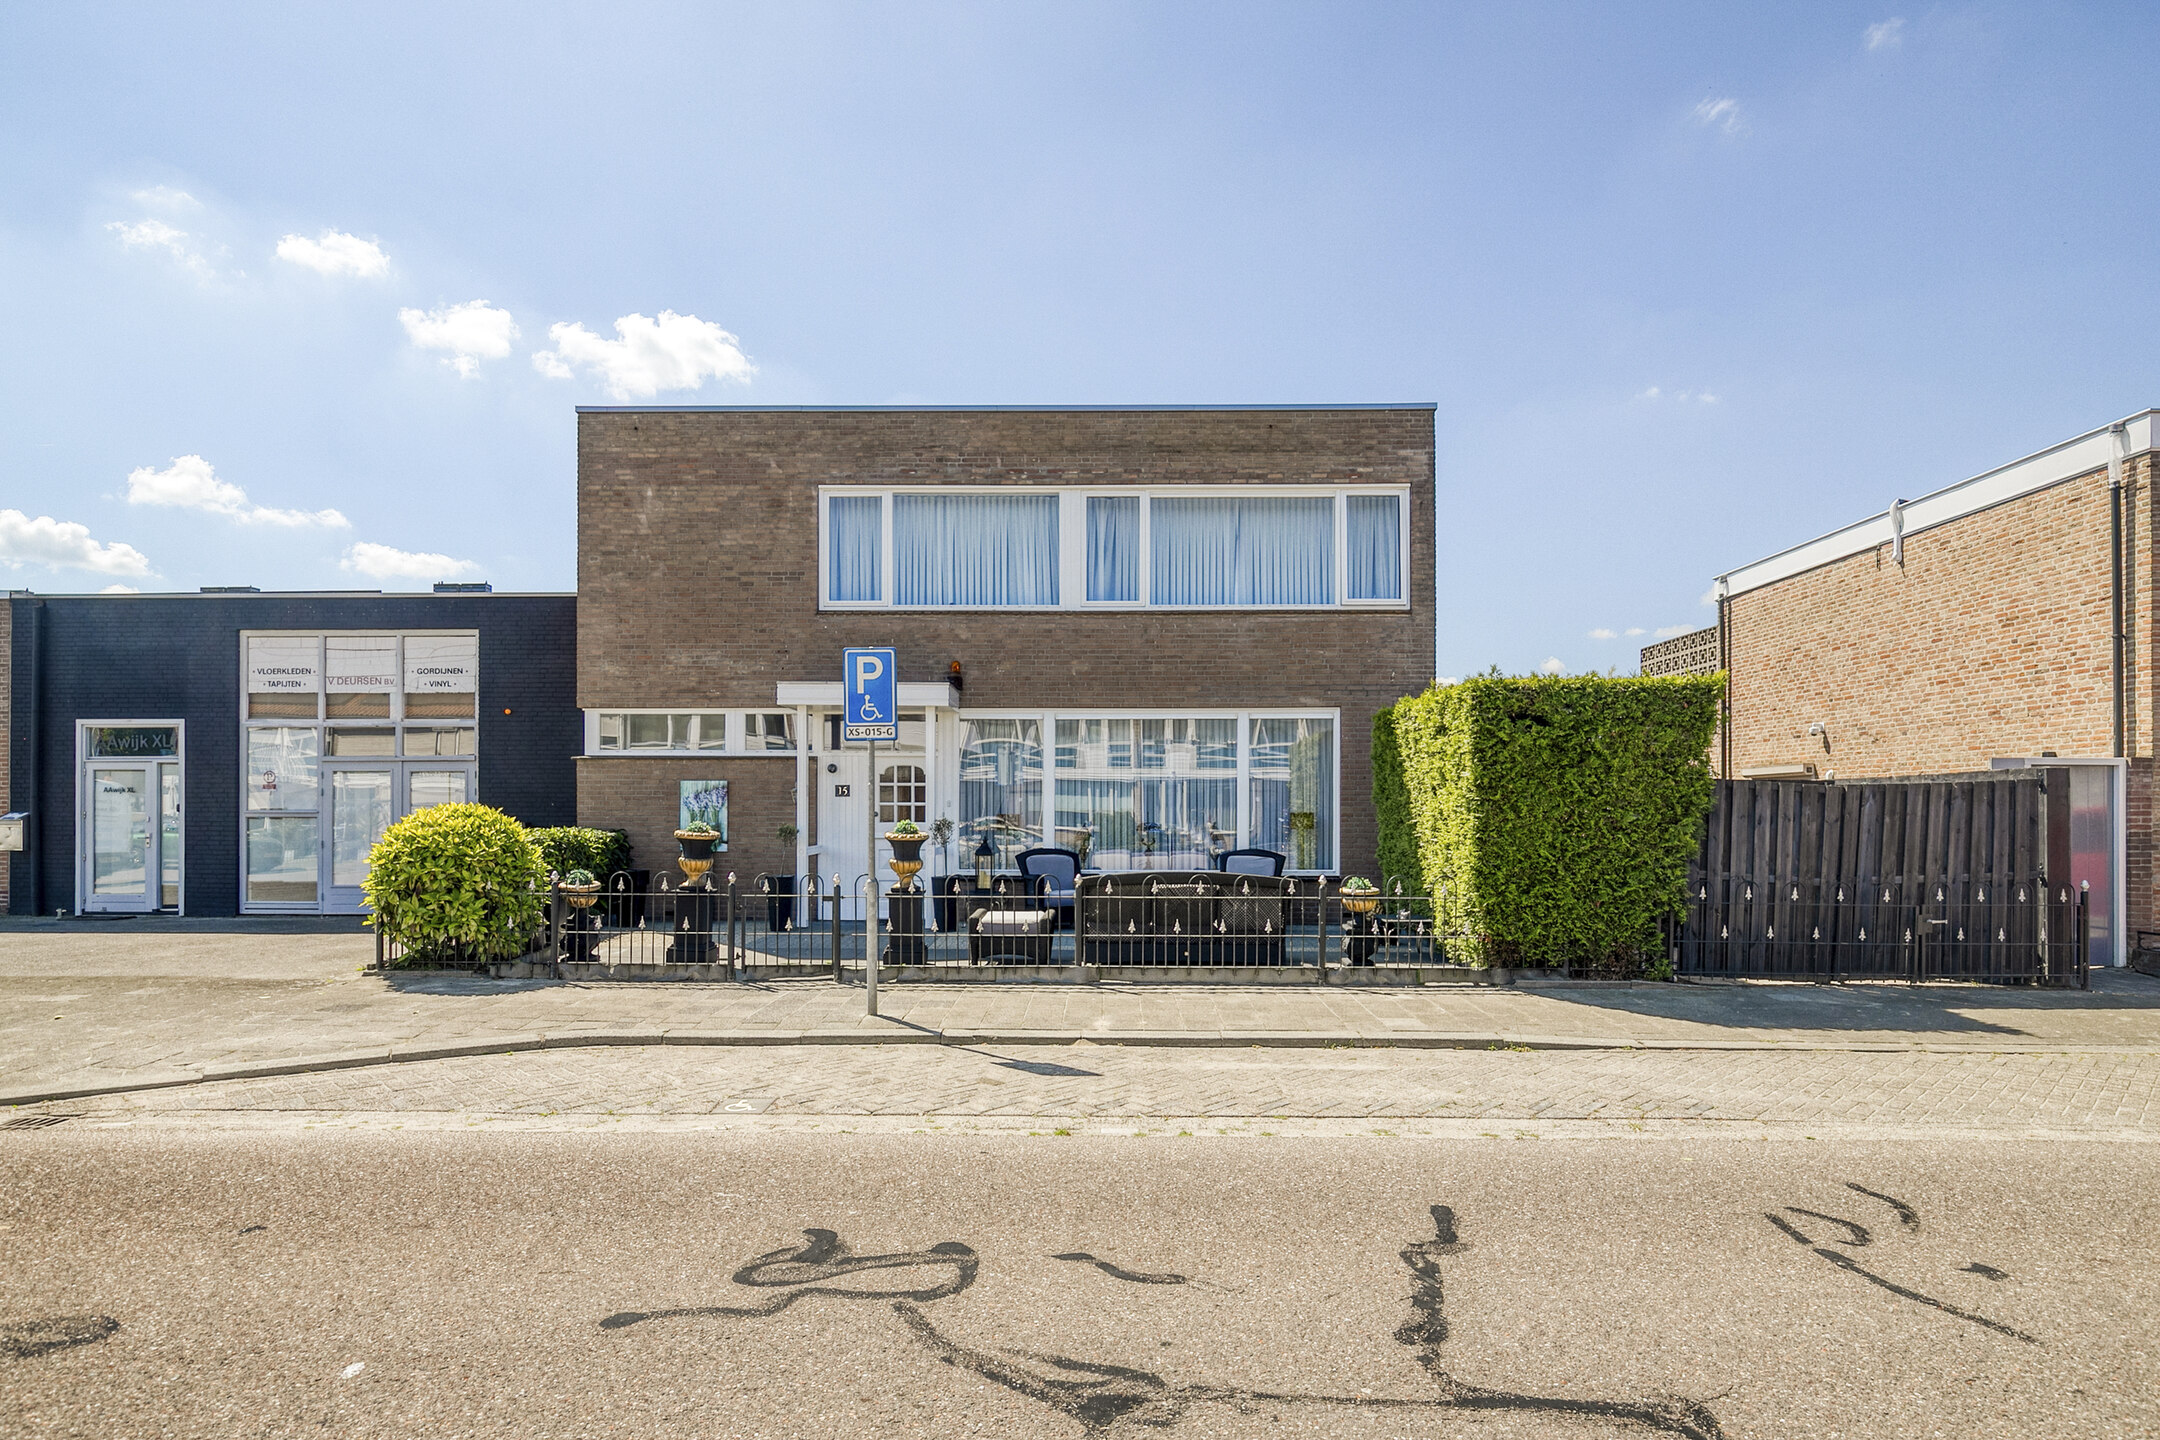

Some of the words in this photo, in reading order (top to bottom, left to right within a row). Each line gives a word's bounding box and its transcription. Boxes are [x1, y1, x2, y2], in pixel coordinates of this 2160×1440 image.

[256, 667, 312, 676] VLOERKLEDEN
[416, 667, 464, 675] GORDIJNEN
[856, 655, 883, 694] P
[267, 680, 302, 688] TAPIJTEN
[336, 676, 382, 686] DEURSEN
[384, 677, 395, 686] BV
[428, 680, 452, 688] VINYL
[847, 727, 893, 737] XS-015-G
[152, 734, 172, 748] XL
[127, 786, 136, 794] XL
[838, 786, 849, 796] 15
